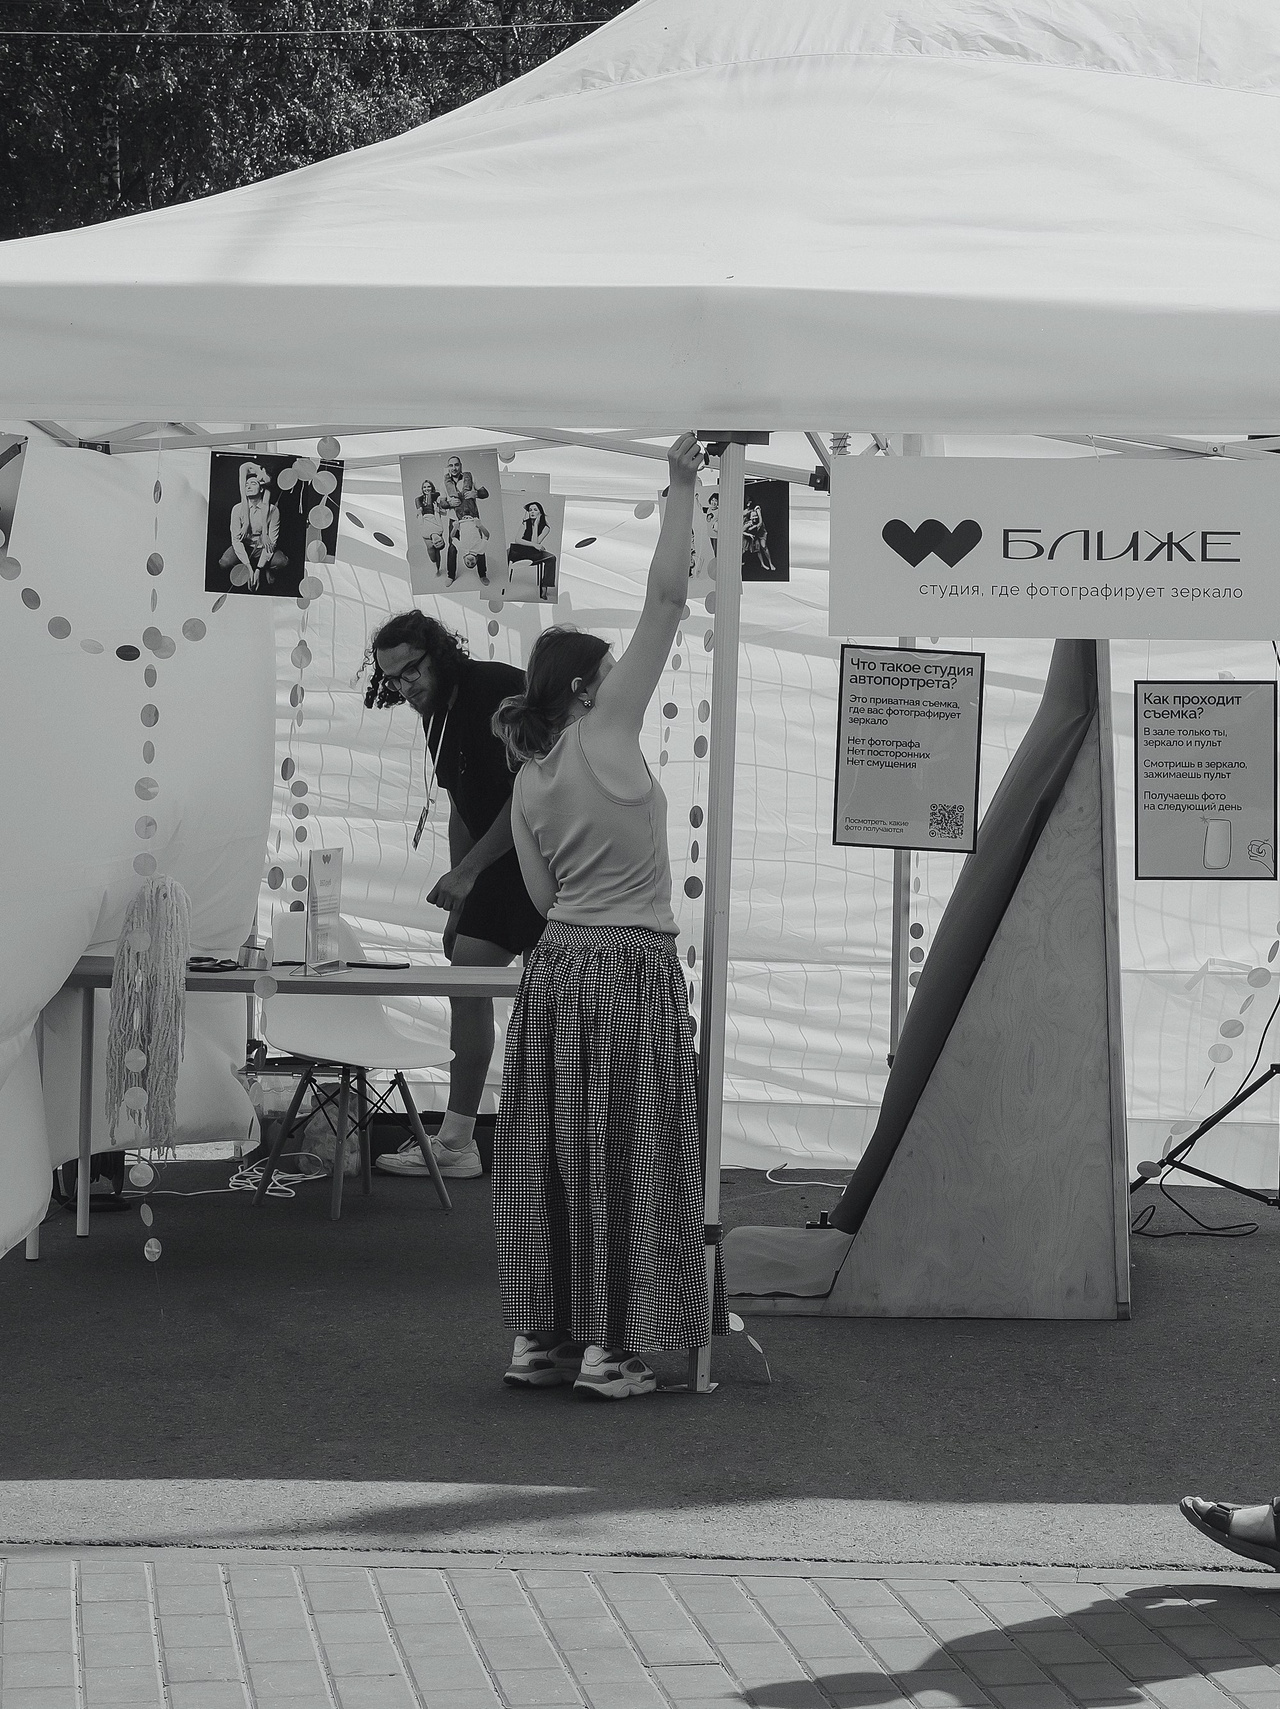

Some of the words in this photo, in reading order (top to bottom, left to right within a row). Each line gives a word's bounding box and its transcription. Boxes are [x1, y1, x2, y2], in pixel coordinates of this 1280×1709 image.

[1002, 528, 1241, 563] БЛИЖЕ
[919, 583, 985, 598] студия,
[991, 583, 1020, 598] где
[1026, 581, 1165, 601] фотографирует
[1170, 586, 1243, 601] зеркало
[850, 657, 877, 671] Что
[880, 661, 921, 673] такое
[924, 665, 974, 677] студия
[849, 674, 957, 690] автопортрета?
[849, 695, 868, 703] Это
[870, 696, 920, 707] приватная
[922, 699, 960, 709] съемка,
[1143, 693, 1170, 705] Как
[1173, 695, 1242, 707] проходит
[849, 705, 865, 715] где
[867, 707, 884, 715] вас
[886, 706, 961, 720] фотографирует
[1143, 707, 1204, 719] съемка?
[848, 717, 888, 726] зеркало
[1144, 728, 1151, 736] В
[1213, 729, 1228, 738] ты,
[847, 736, 866, 745] Нет
[868, 737, 920, 749] фотографа
[1143, 739, 1184, 748] зеркало
[1186, 739, 1192, 747] и
[1195, 739, 1222, 749] пульт
[847, 747, 865, 756] Нет
[867, 749, 930, 760] посторонних
[846, 758, 865, 766] Нет
[867, 760, 917, 770] смущения
[1143, 760, 1195, 770] Смотришь
[1205, 761, 1248, 770] зеркало,
[1143, 771, 1201, 779] зажимаешь
[1204, 771, 1231, 781] пульт
[1143, 791, 1199, 802] Получаешь
[1201, 792, 1226, 802] фото
[1143, 803, 1155, 811] на
[1157, 802, 1216, 813] следующий
[1218, 803, 1242, 813] день
[844, 824, 863, 832] фото
[865, 825, 903, 834] получаются
